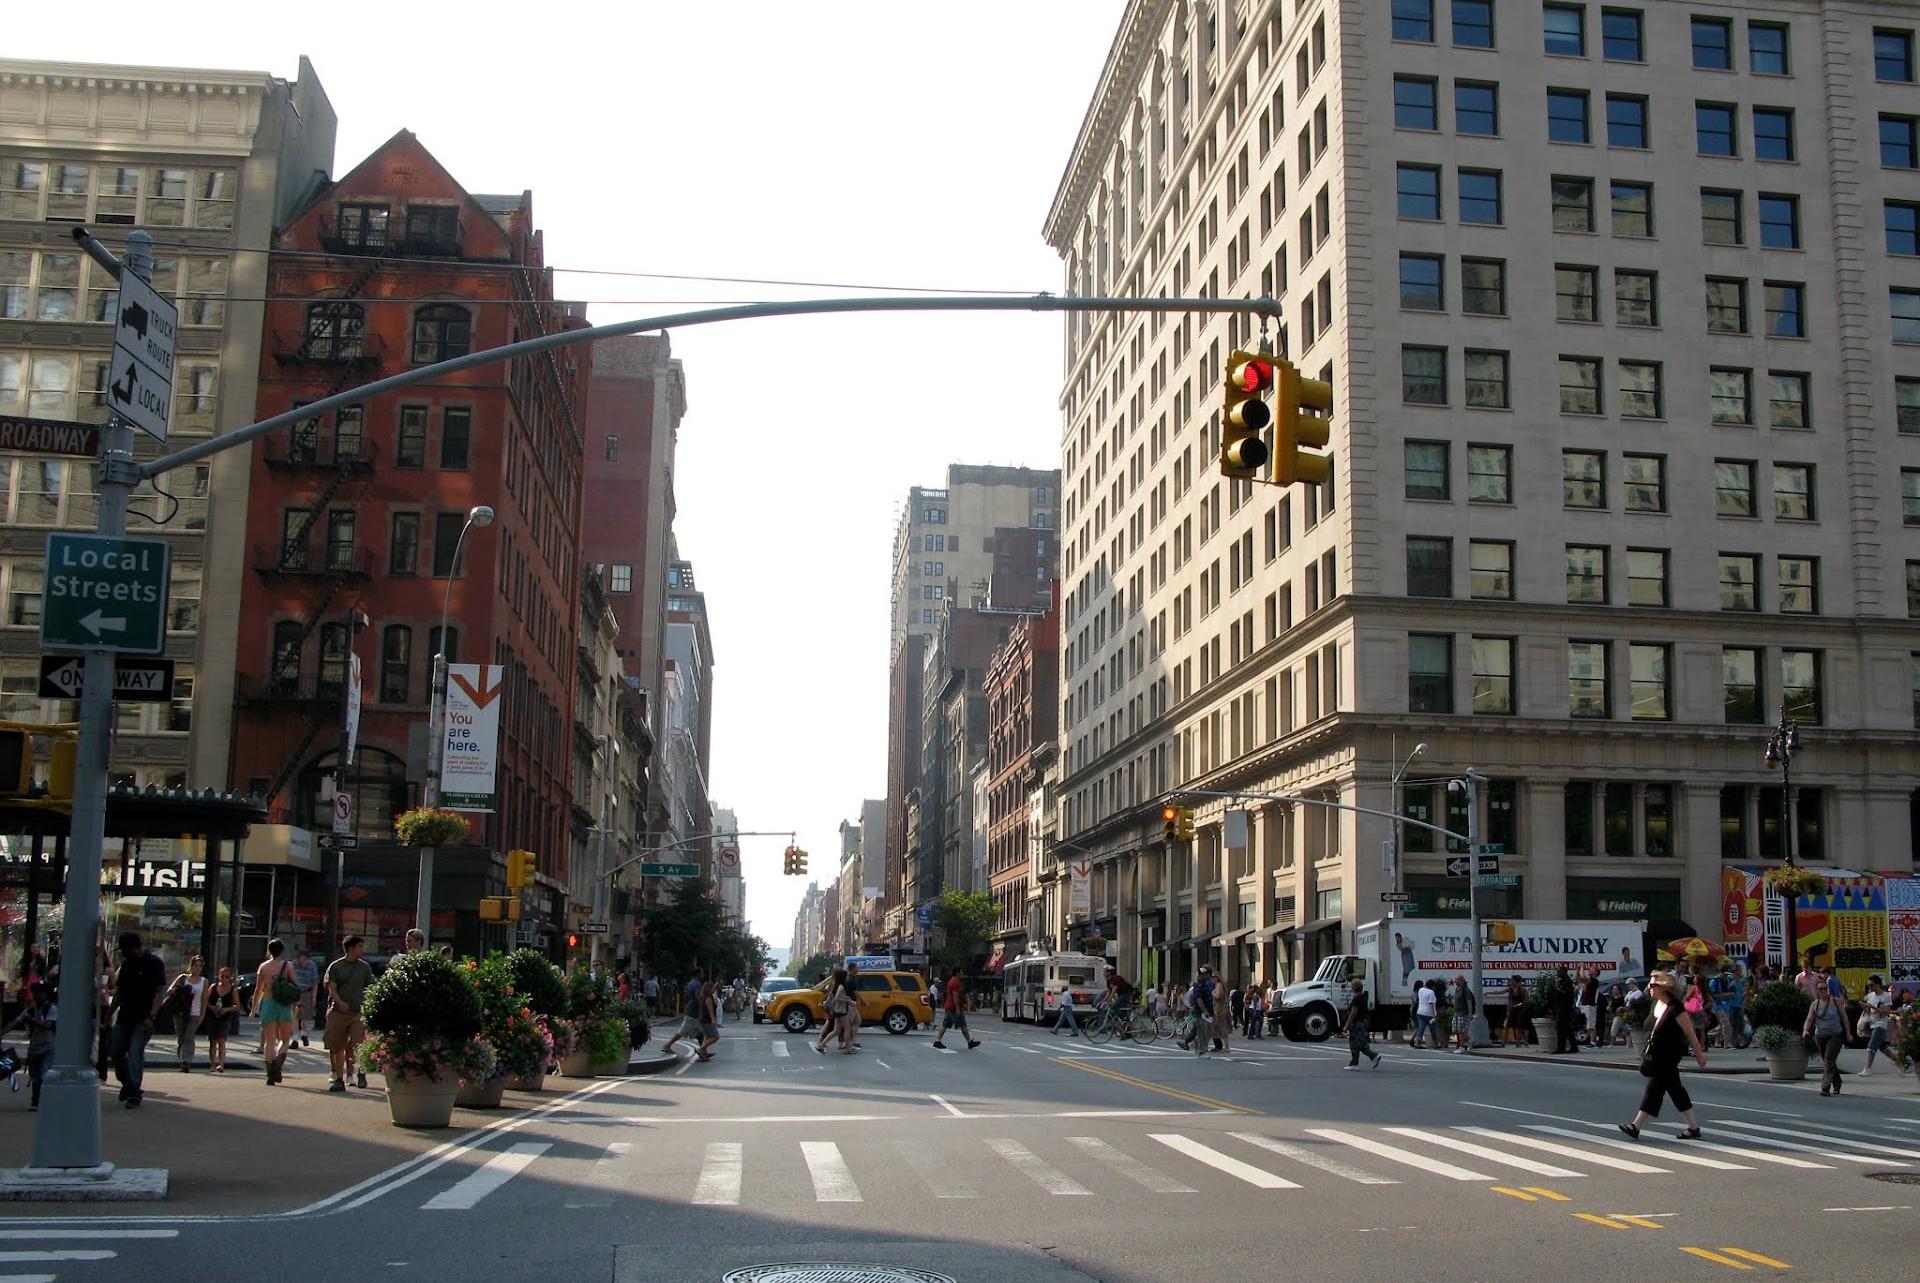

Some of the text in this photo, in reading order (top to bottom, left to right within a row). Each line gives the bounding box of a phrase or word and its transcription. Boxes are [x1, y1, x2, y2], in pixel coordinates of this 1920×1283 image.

[150, 311, 174, 338] TRUCK
[147, 338, 170, 369] ROUTE
[138, 384, 166, 421] LOCAL
[0, 421, 91, 450] ROADWAY
[63, 545, 150, 572] Local
[51, 575, 157, 602] Streets
[60, 669, 156, 688] ON WAY
[450, 712, 473, 725] You
[449, 727, 471, 738] are
[448, 738, 480, 752] here.
[658, 865, 665, 874] 5
[1479, 874, 1516, 885] BROADWAY
[1608, 900, 1648, 913] Fidelity
[1498, 937, 1608, 954] LAUNDRY
[1422, 961, 1448, 969] HOTELS
[1494, 961, 1528, 969] CLEANING
